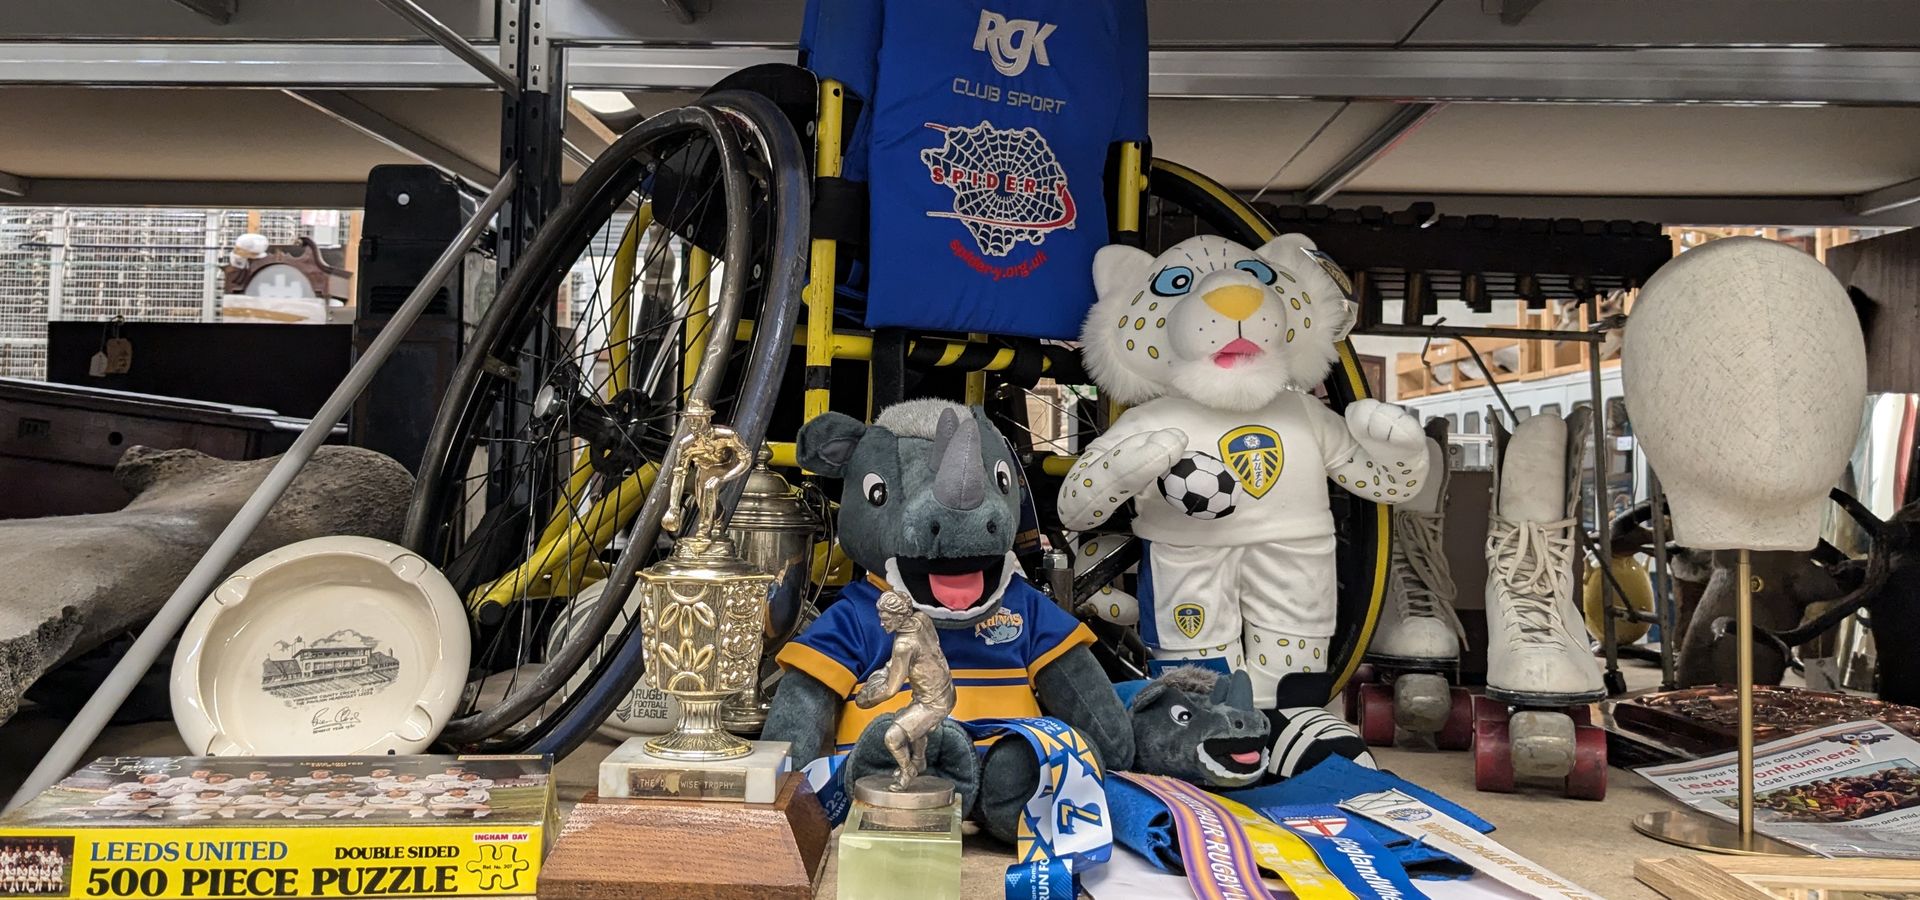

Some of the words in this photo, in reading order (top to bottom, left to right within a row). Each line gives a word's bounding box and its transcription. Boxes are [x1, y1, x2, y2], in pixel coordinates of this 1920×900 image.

[952, 77, 1000, 102] CLUB
[1007, 91, 1066, 115] SPORT
[634, 689, 668, 700] RUGBY
[634, 701, 668, 709] FOOTBALL
[633, 708, 668, 719] LEAGUE
[1668, 774, 1699, 784] Grab
[1702, 770, 1728, 781] your
[1730, 760, 1773, 775] trers
[1776, 754, 1797, 764] and
[1799, 748, 1820, 759] join
[1678, 778, 1736, 791] Leeds
[1737, 747, 1860, 779] ontRunners!
[1757, 776, 1786, 788] LGBT
[1789, 765, 1834, 780] running
[1834, 757, 1861, 769] club
[640, 779, 655, 787] THE
[680, 780, 699, 789] WISE
[704, 781, 734, 789] TROPHY
[1881, 817, 1900, 825] and
[90, 841, 179, 862] LEEDS
[185, 841, 288, 862] UNITED
[335, 846, 404, 860] DOUBLE
[407, 845, 460, 858] SIDED
[1205, 838, 1241, 890] RUGBY
[86, 867, 168, 897] 500
[181, 867, 299, 897] PIECE
[311, 865, 459, 896] PUZZLE
